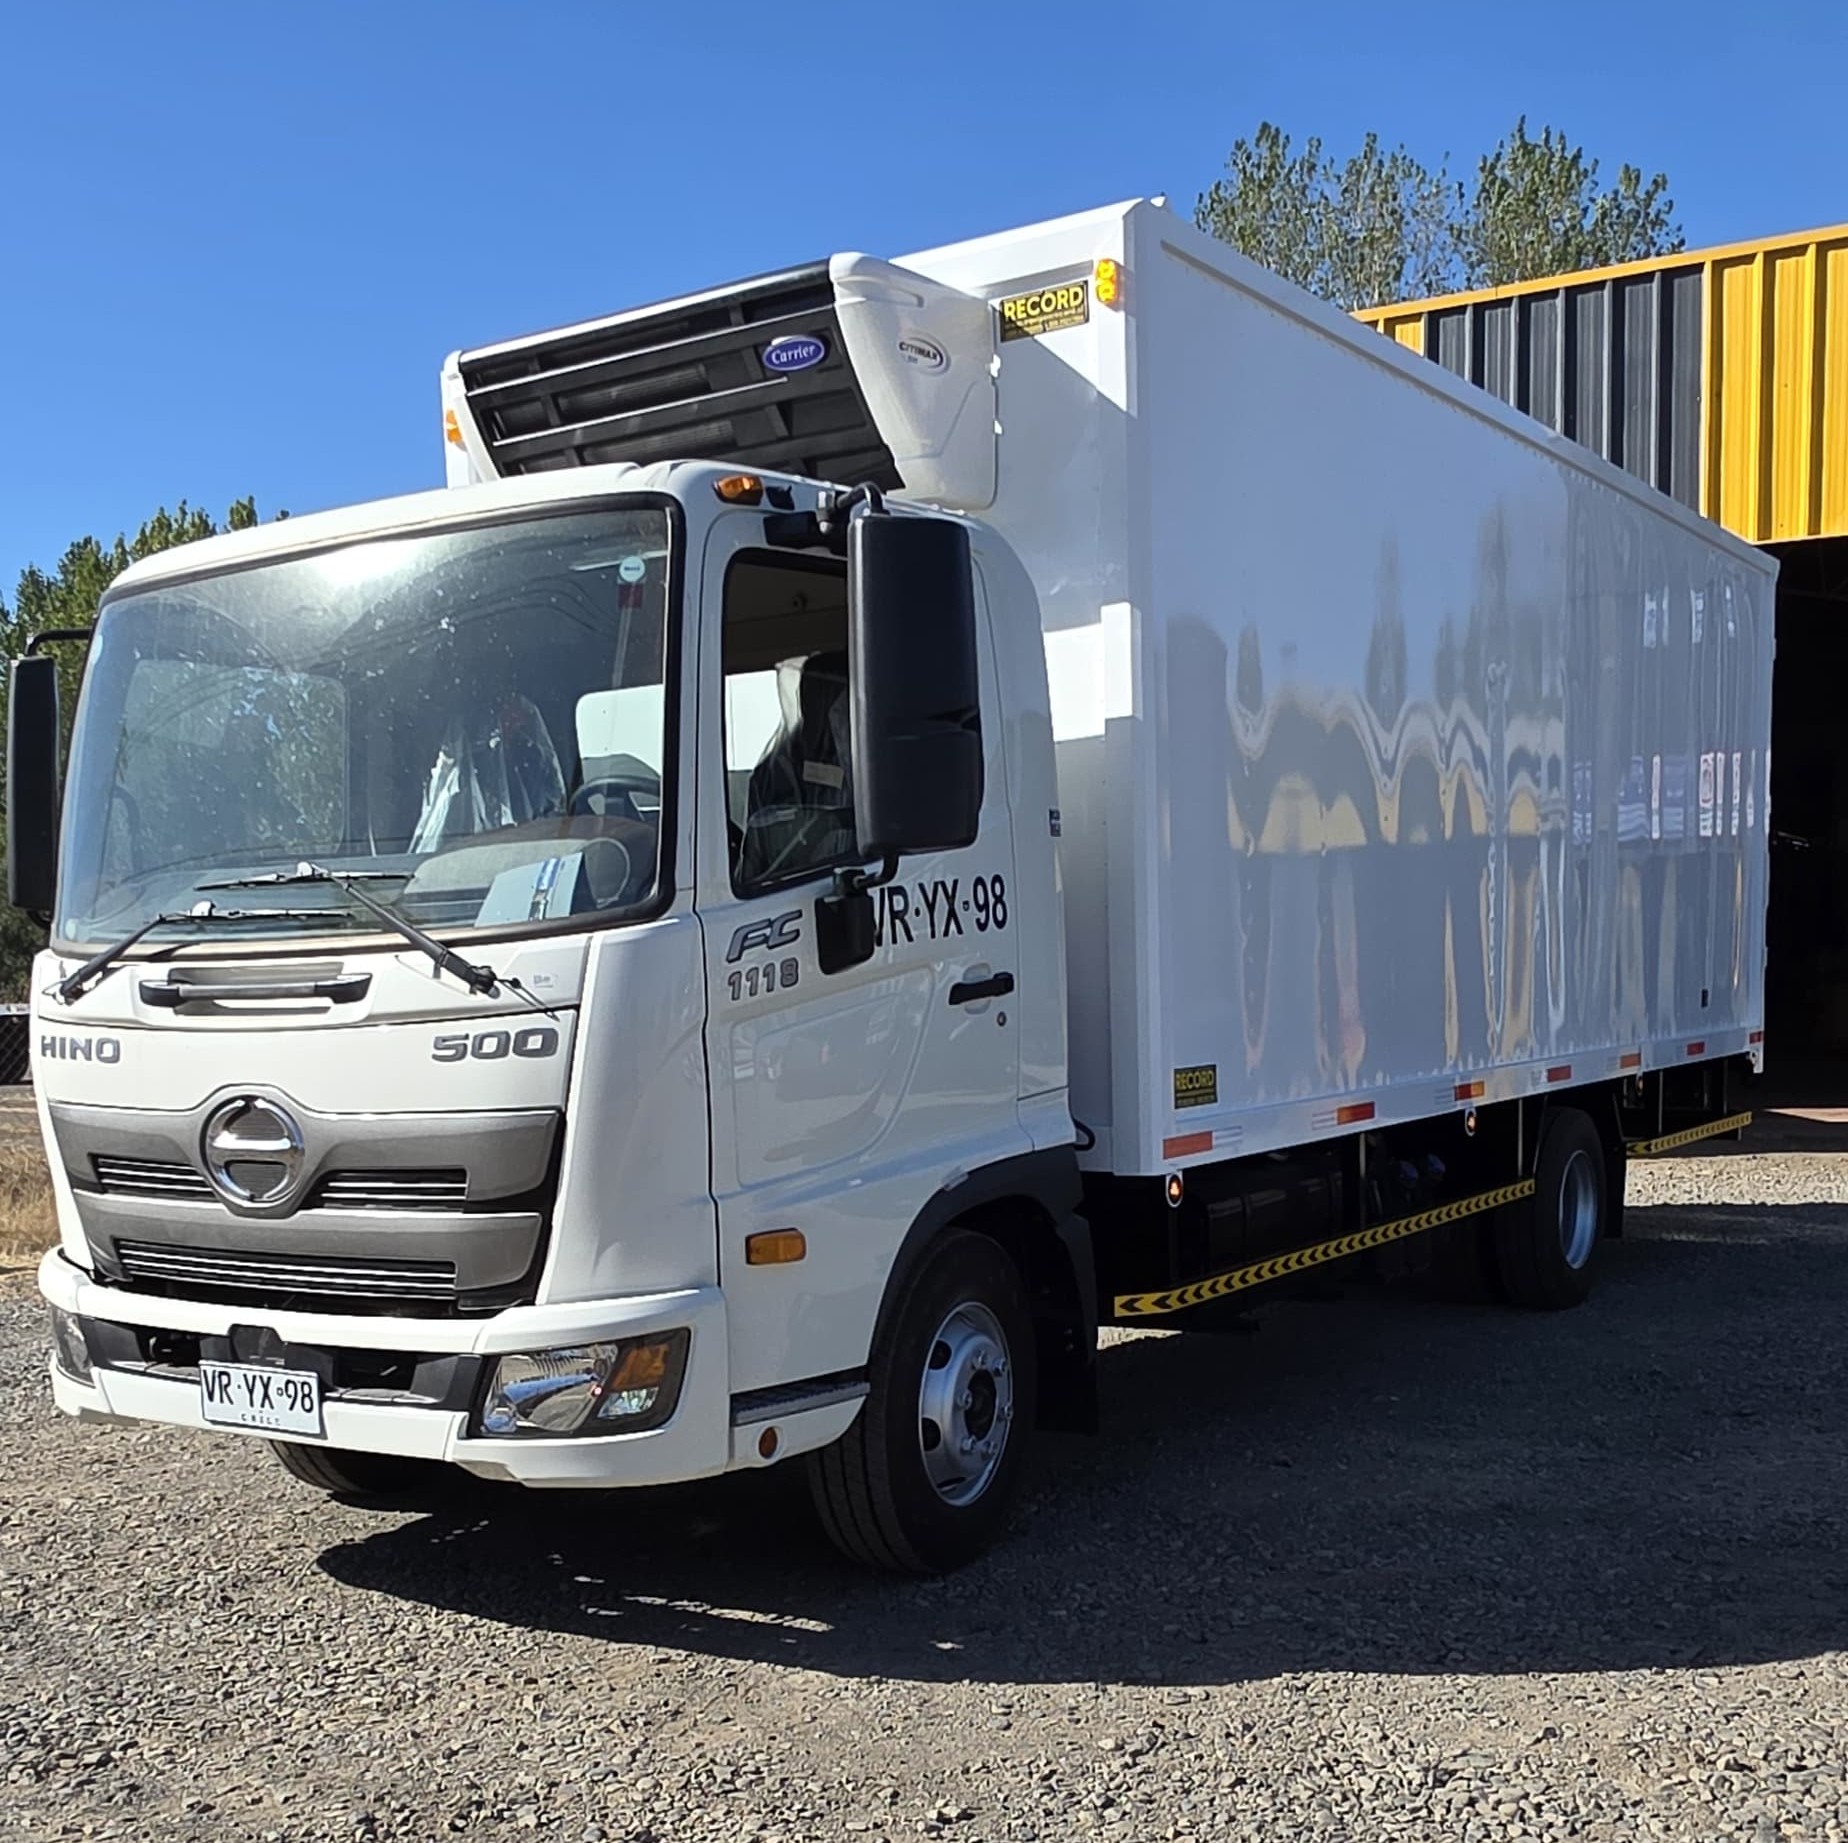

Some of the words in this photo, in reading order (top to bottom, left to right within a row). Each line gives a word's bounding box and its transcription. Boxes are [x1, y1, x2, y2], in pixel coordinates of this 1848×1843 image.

[1003, 286, 1084, 321] RECORD
[771, 343, 817, 365] Carrier
[726, 909, 803, 964] FC
[727, 956, 799, 1001] 1118
[41, 1035, 121, 1064] HINO
[431, 1027, 559, 1063] 500
[1175, 1070, 1214, 1090] RECORD
